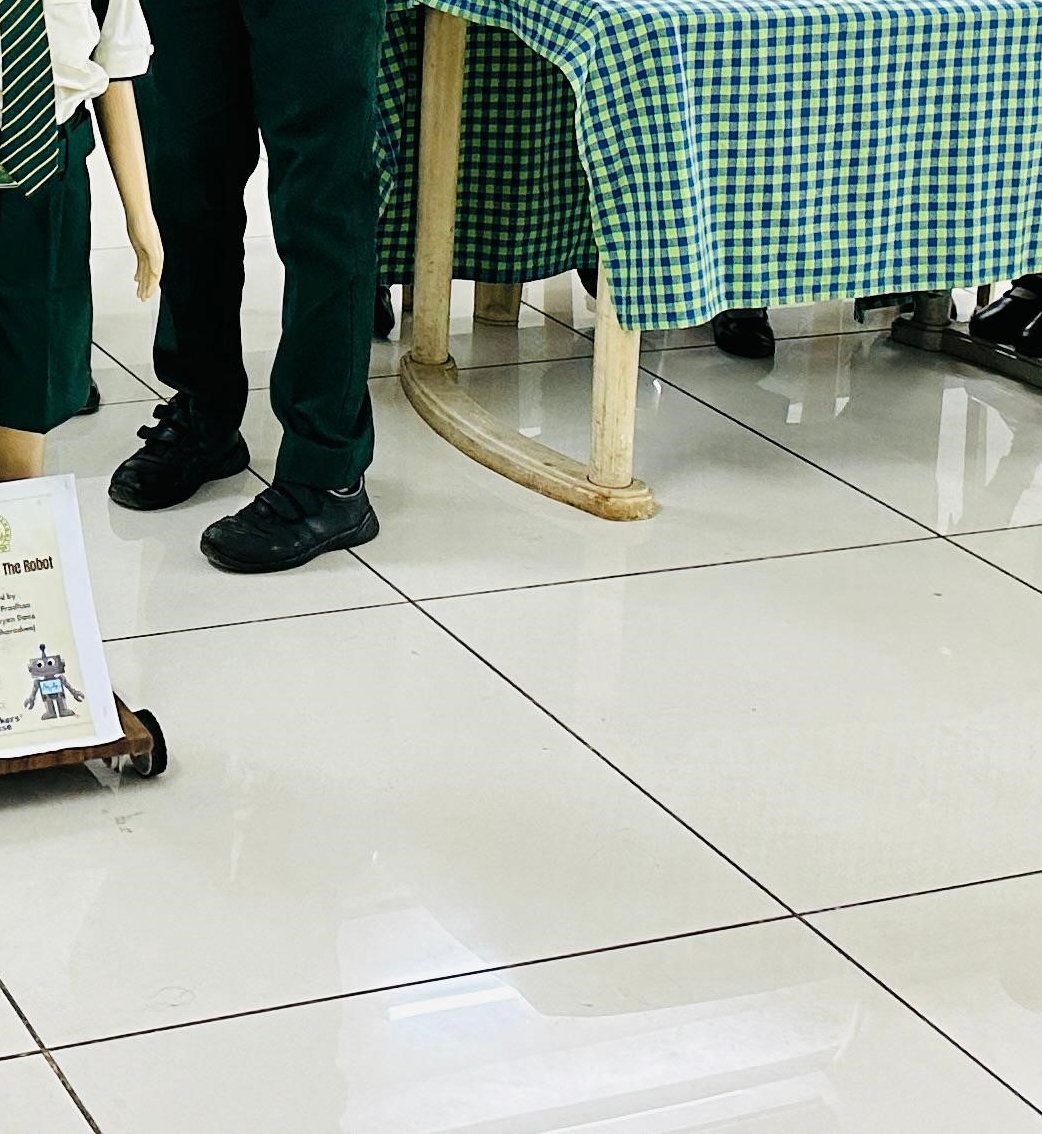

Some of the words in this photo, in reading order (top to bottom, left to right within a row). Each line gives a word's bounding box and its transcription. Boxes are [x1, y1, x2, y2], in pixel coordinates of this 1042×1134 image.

[2, 562, 22, 576] The
[23, 556, 54, 573] Robot
[6, 592, 16, 602] by
